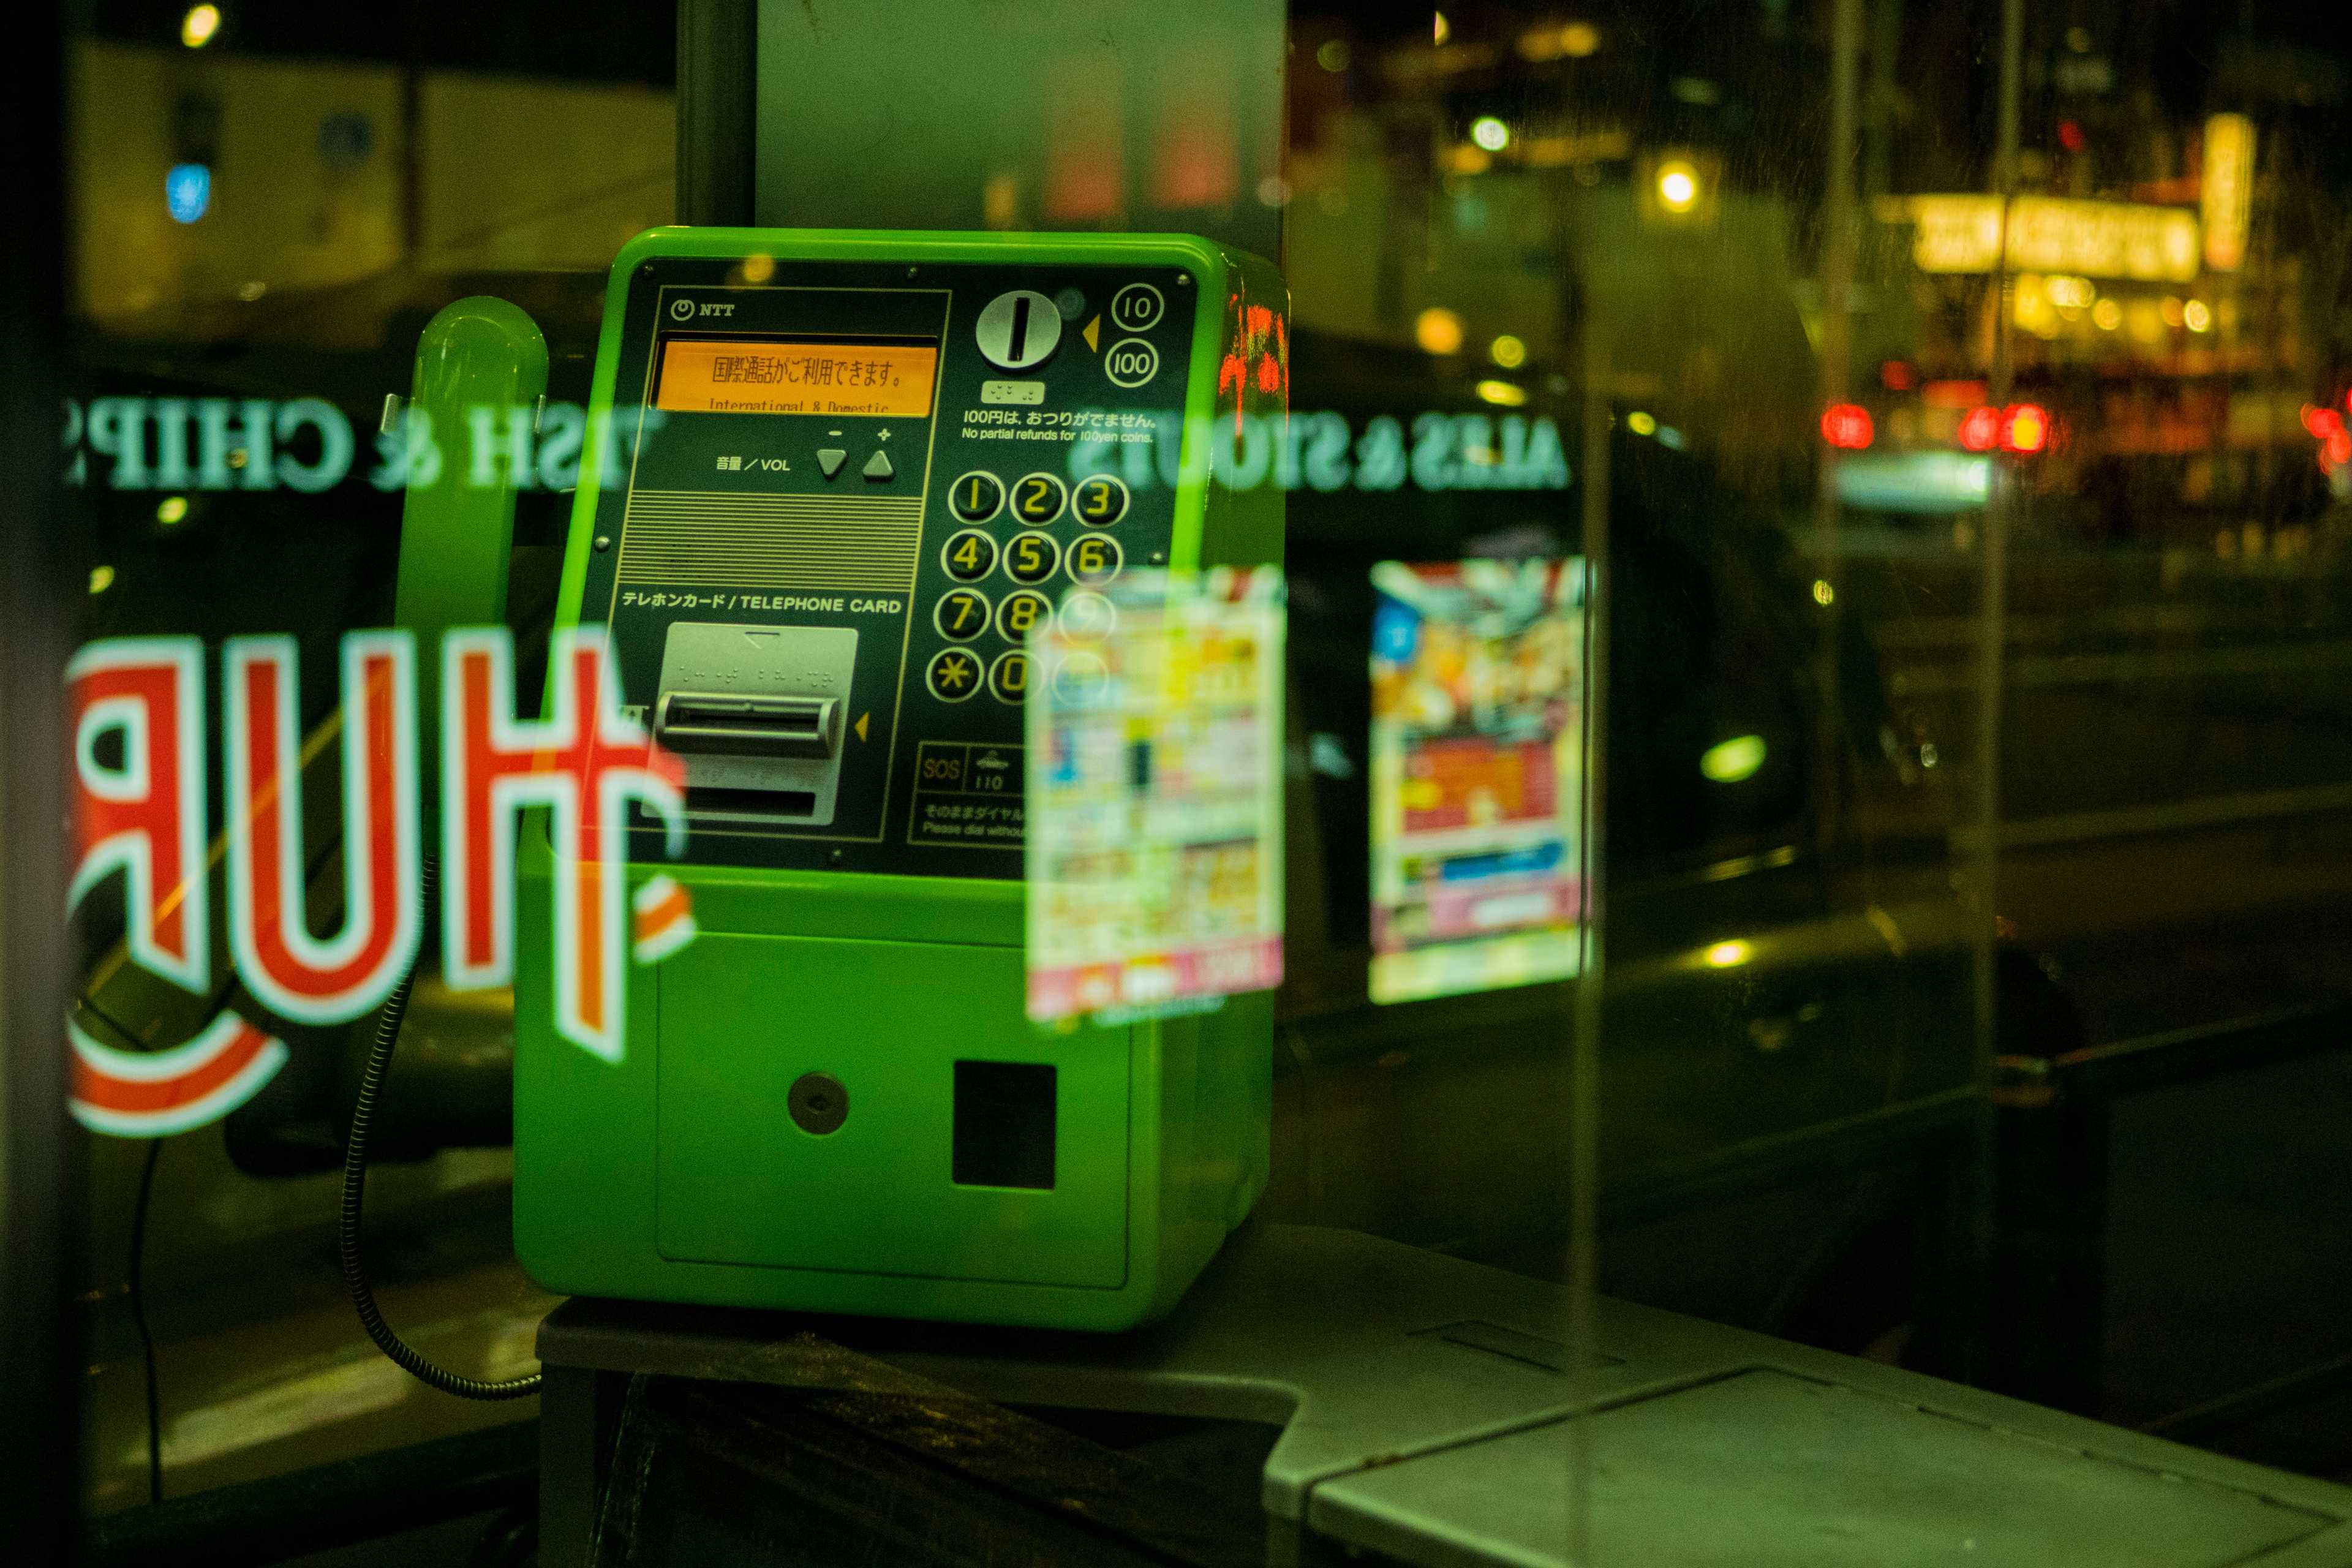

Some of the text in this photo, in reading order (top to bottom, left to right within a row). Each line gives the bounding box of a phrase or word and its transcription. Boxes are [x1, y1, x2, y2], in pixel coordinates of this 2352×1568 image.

[699, 304, 734, 317] NTT
[1125, 298, 1150, 318] 10
[712, 355, 899, 387] 国際通話がご利用できます。
[1114, 353, 1150, 374] 100
[962, 428, 978, 439] No
[980, 429, 1014, 441] partial
[1016, 429, 1058, 441] refunds
[1060, 430, 1076, 441] for
[1120, 432, 1153, 443] coins.
[970, 479, 979, 510] 1
[1024, 480, 1048, 513] 2
[1087, 483, 1110, 514] 3
[953, 537, 978, 569] 4
[1017, 538, 1041, 571] 5
[1079, 540, 1105, 574] 6
[622, 592, 725, 608] テレホンカード
[741, 595, 844, 612] TELEPHONE
[850, 598, 902, 613] CARD
[951, 597, 973, 630] 7
[1009, 598, 1038, 631] 8
[1001, 657, 1030, 691] 0
[923, 758, 961, 780] SOS
[976, 775, 1003, 790] 110
[922, 821, 962, 834] Please
[986, 826, 1025, 837] withou
